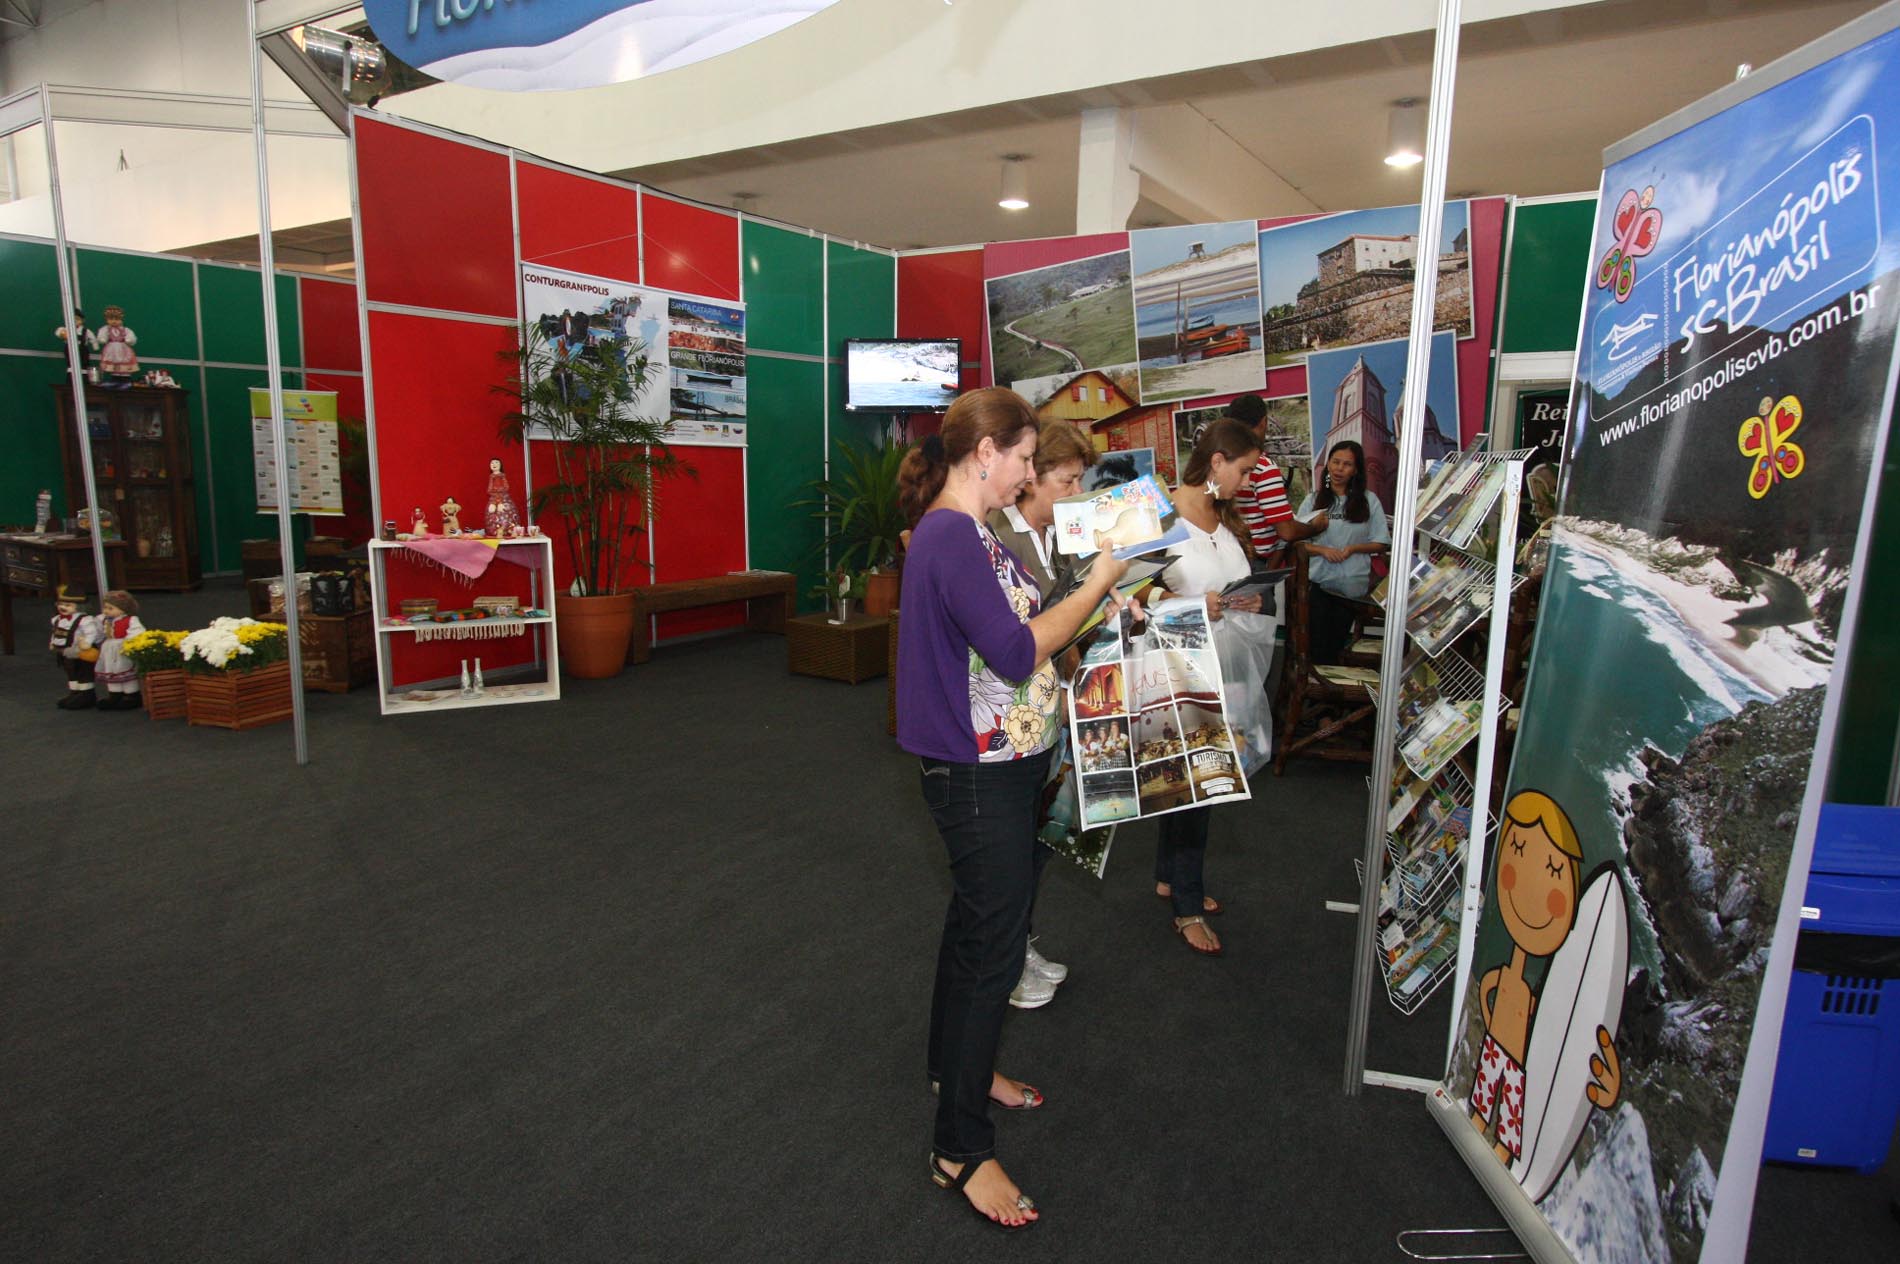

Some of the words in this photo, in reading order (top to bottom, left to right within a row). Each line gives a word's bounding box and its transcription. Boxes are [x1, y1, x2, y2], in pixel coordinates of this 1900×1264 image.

[524, 273, 610, 296] CONTURGRANFPOLIS
[670, 301, 691, 313] SANTA
[670, 350, 697, 361] GRANDE
[1600, 284, 1881, 448] www.florianopoliscvb.com.br
